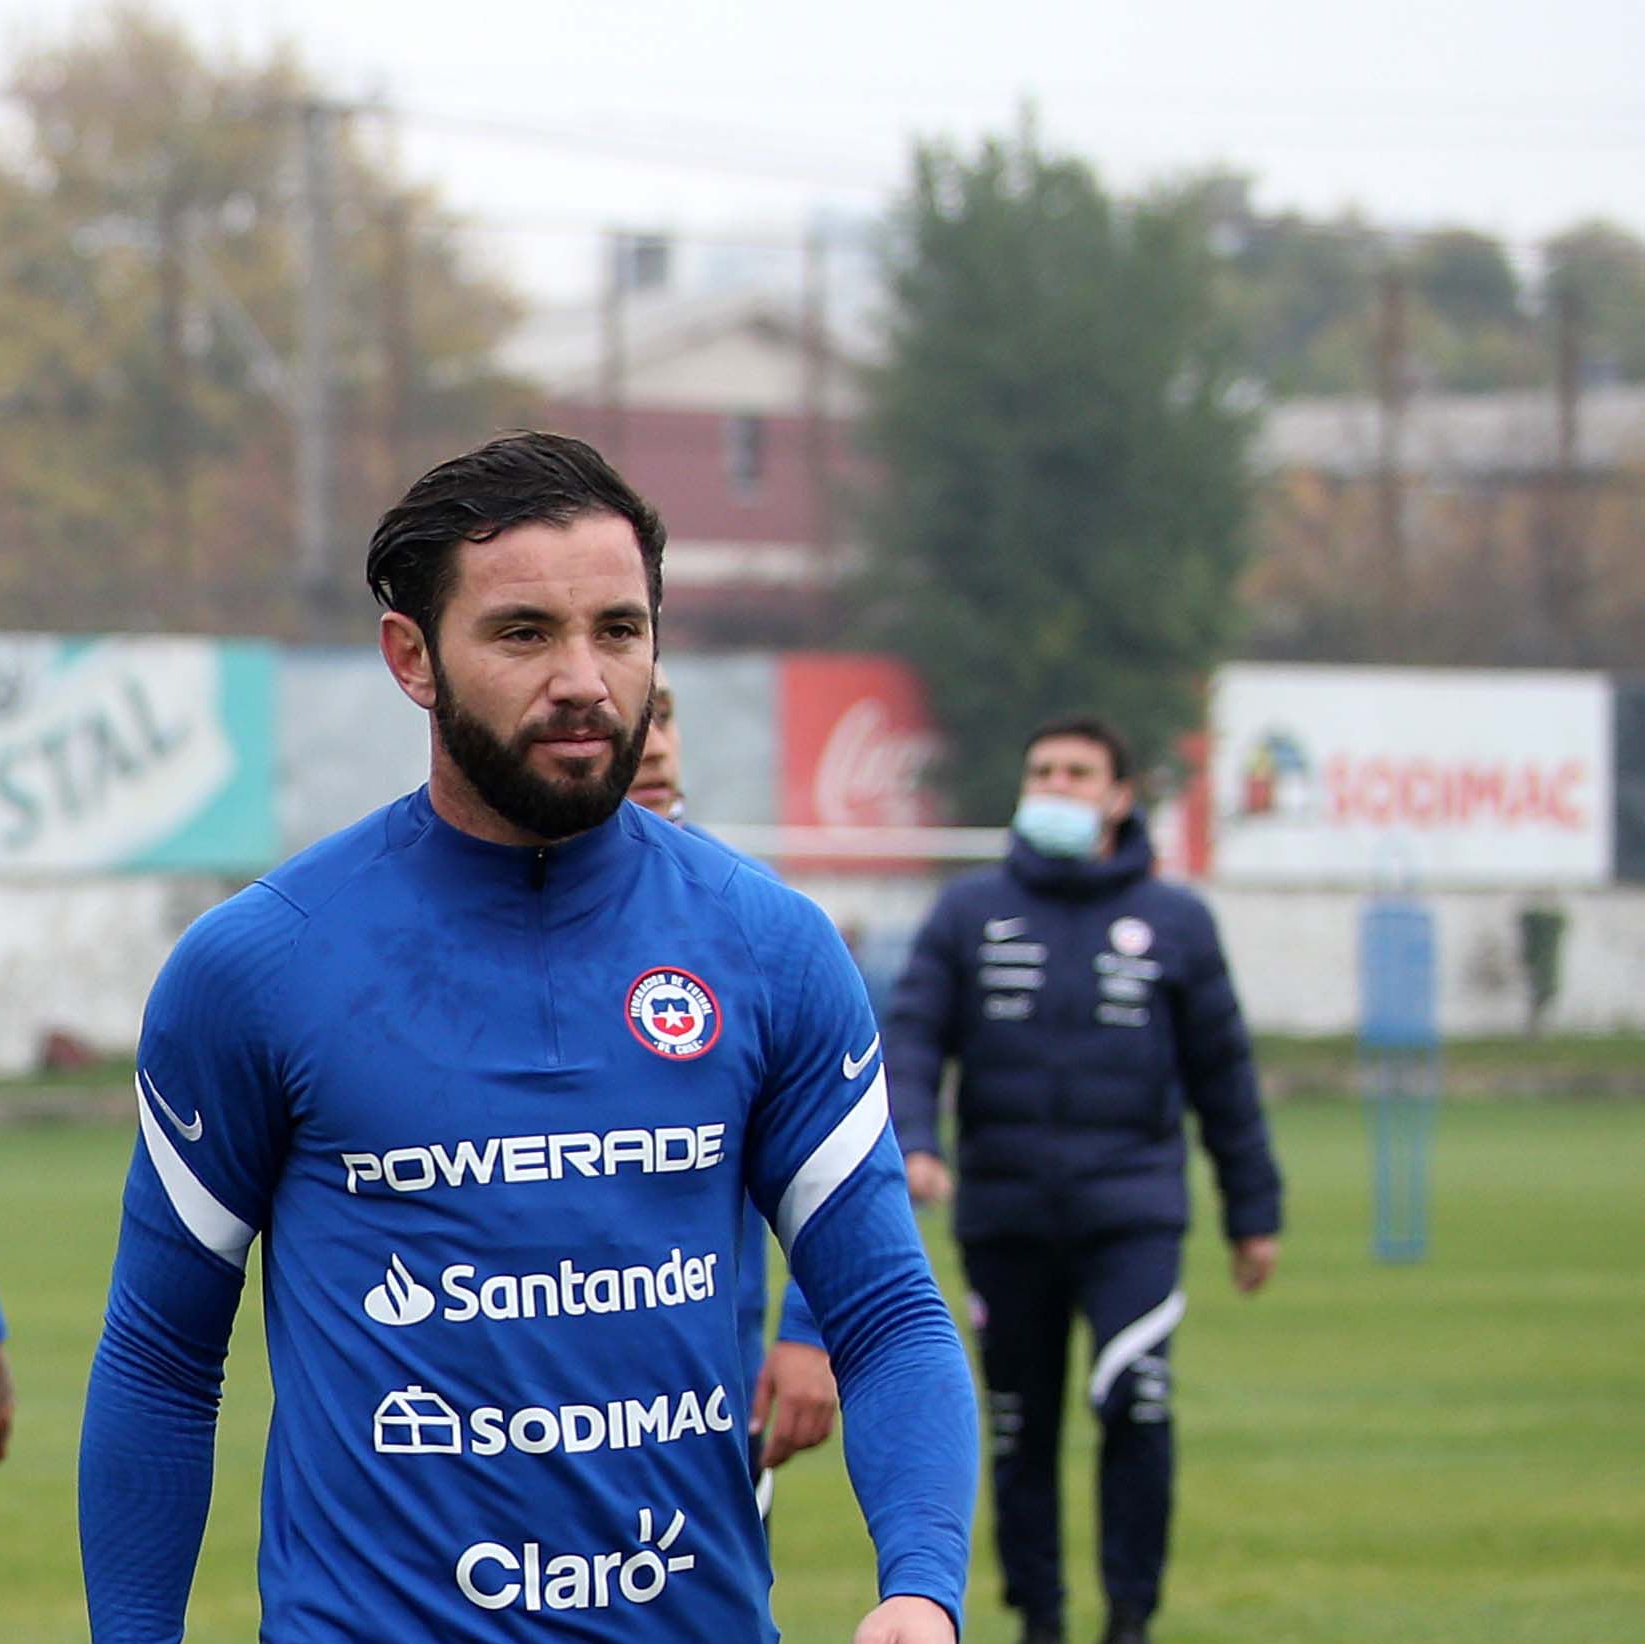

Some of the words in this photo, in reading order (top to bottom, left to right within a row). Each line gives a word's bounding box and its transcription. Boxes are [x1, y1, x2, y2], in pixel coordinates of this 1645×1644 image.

[1319, 750, 1588, 832] SODIMAC
[341, 1123, 725, 1194] POWERADE
[441, 1247, 718, 1322] Santander
[469, 1384, 735, 1456] SODIMAC
[456, 1541, 668, 1611] Claro
